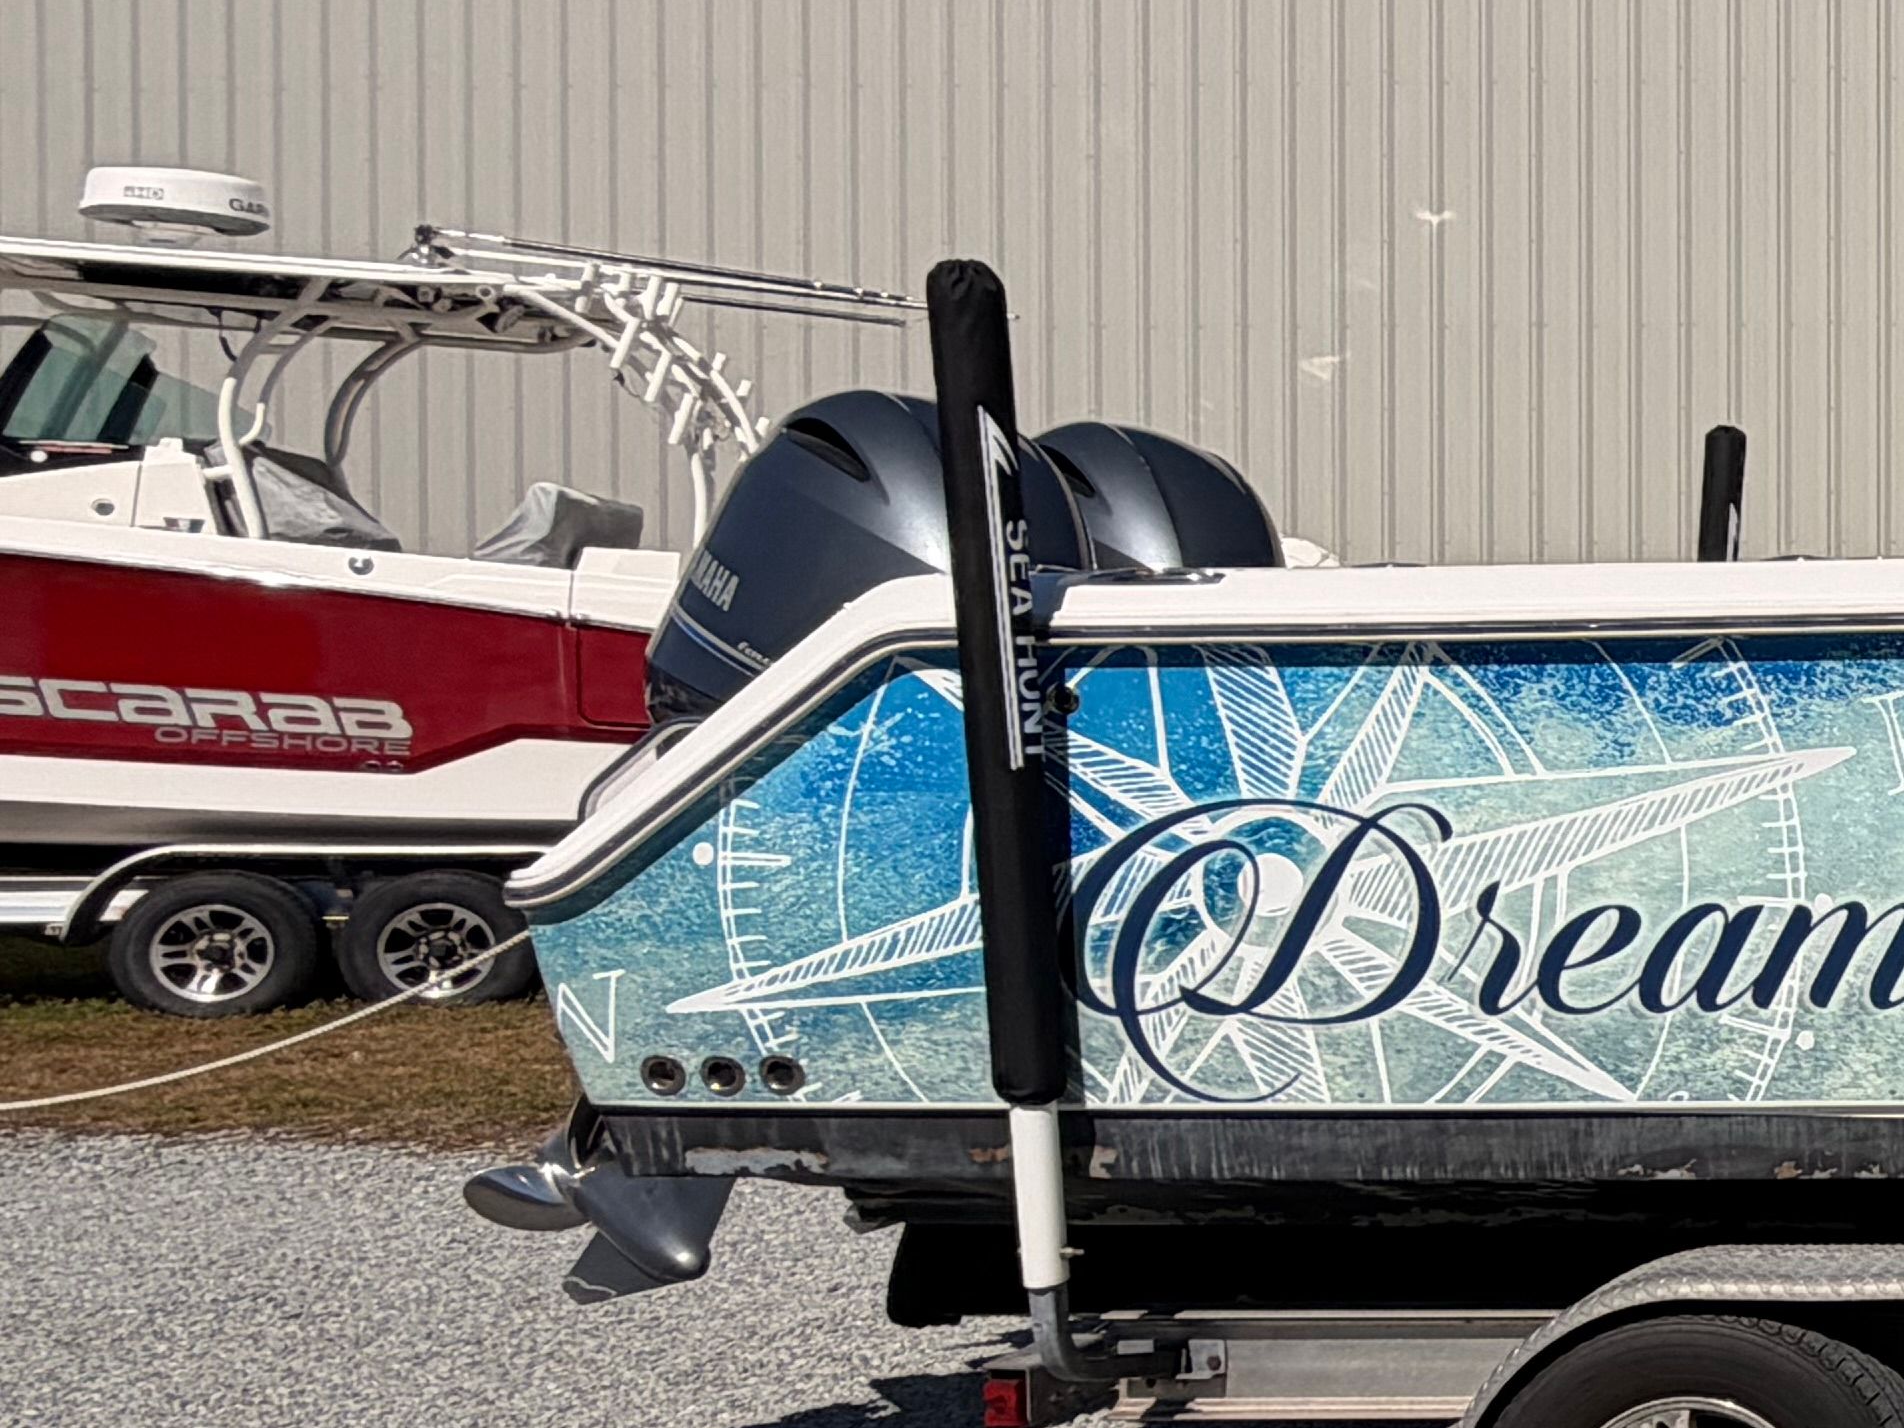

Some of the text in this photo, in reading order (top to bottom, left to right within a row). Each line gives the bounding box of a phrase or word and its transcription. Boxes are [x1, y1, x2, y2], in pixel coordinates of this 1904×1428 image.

[1006, 519, 1046, 756] SEA HUNT
[154, 727, 411, 756] OFFSHORE
